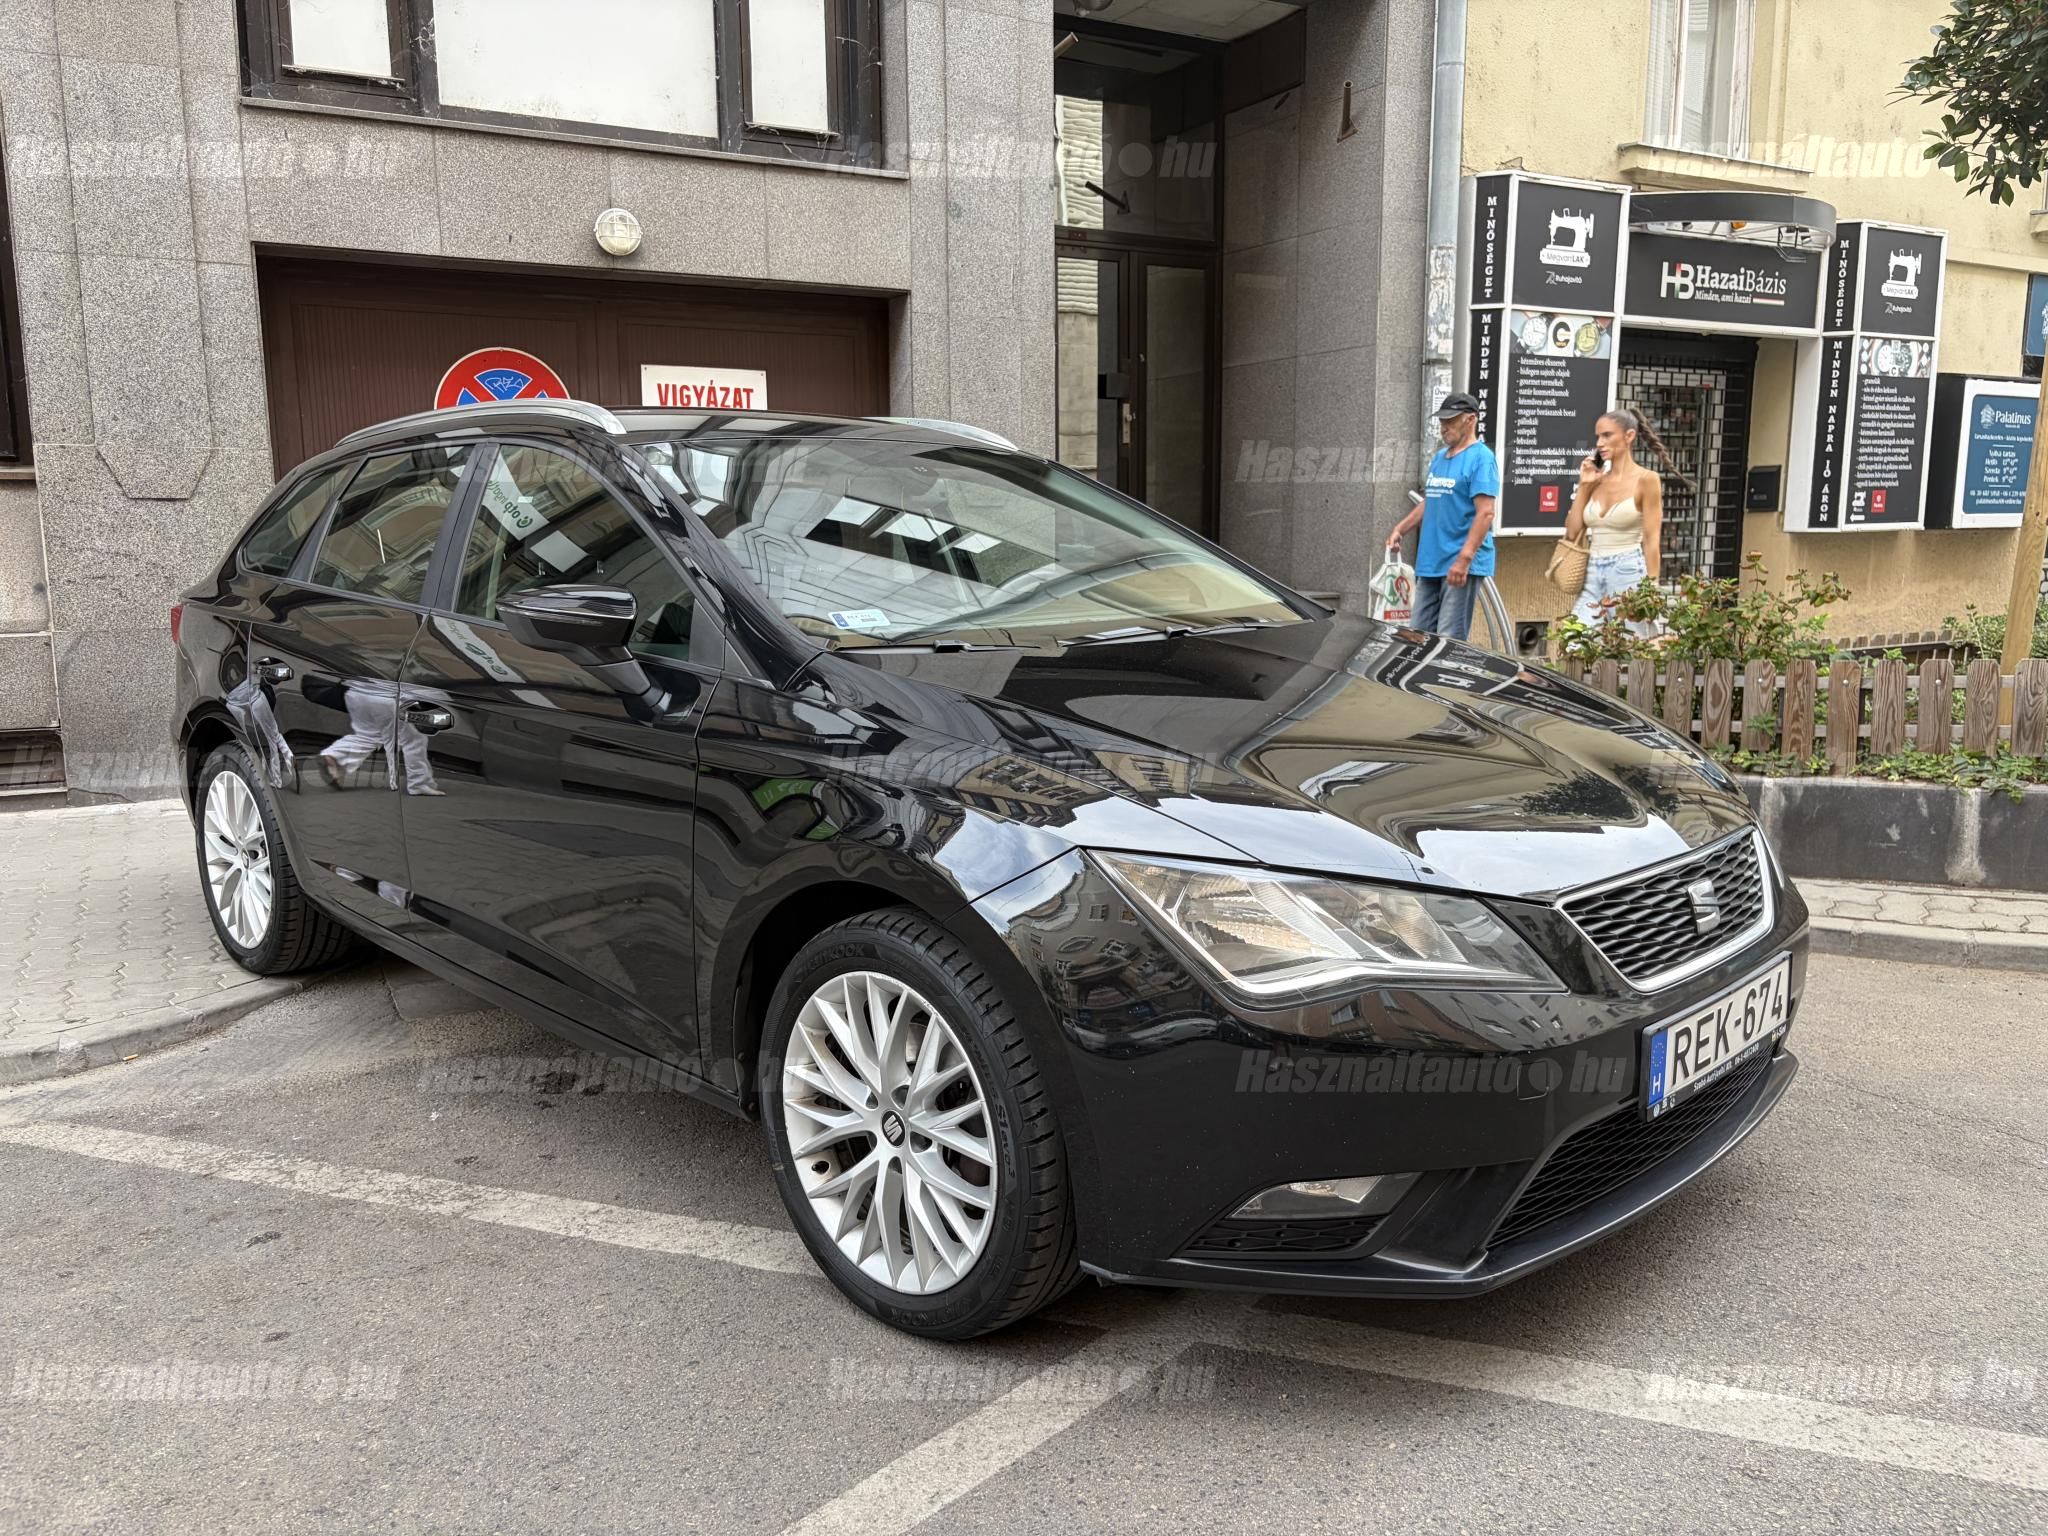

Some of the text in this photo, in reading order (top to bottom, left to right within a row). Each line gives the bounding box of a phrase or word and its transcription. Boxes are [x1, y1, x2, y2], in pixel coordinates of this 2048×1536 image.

[1485, 196, 1498, 298] MINŐSÉGET
[1695, 265, 1787, 295] HazaiBázis
[1695, 290, 1752, 304] Minden, ami hazai
[1835, 240, 1850, 327] MINŐSÉGET
[657, 379, 754, 410] VIGYÁZAT
[1477, 314, 1492, 443] MINDEN NAPRA
[1819, 341, 1843, 522] MINDEN NAPRA JÓ ÁRON
[1995, 410, 2032, 425] Palatinus
[1671, 970, 1784, 1087] REK-674
[1652, 1072, 1662, 1096] H
